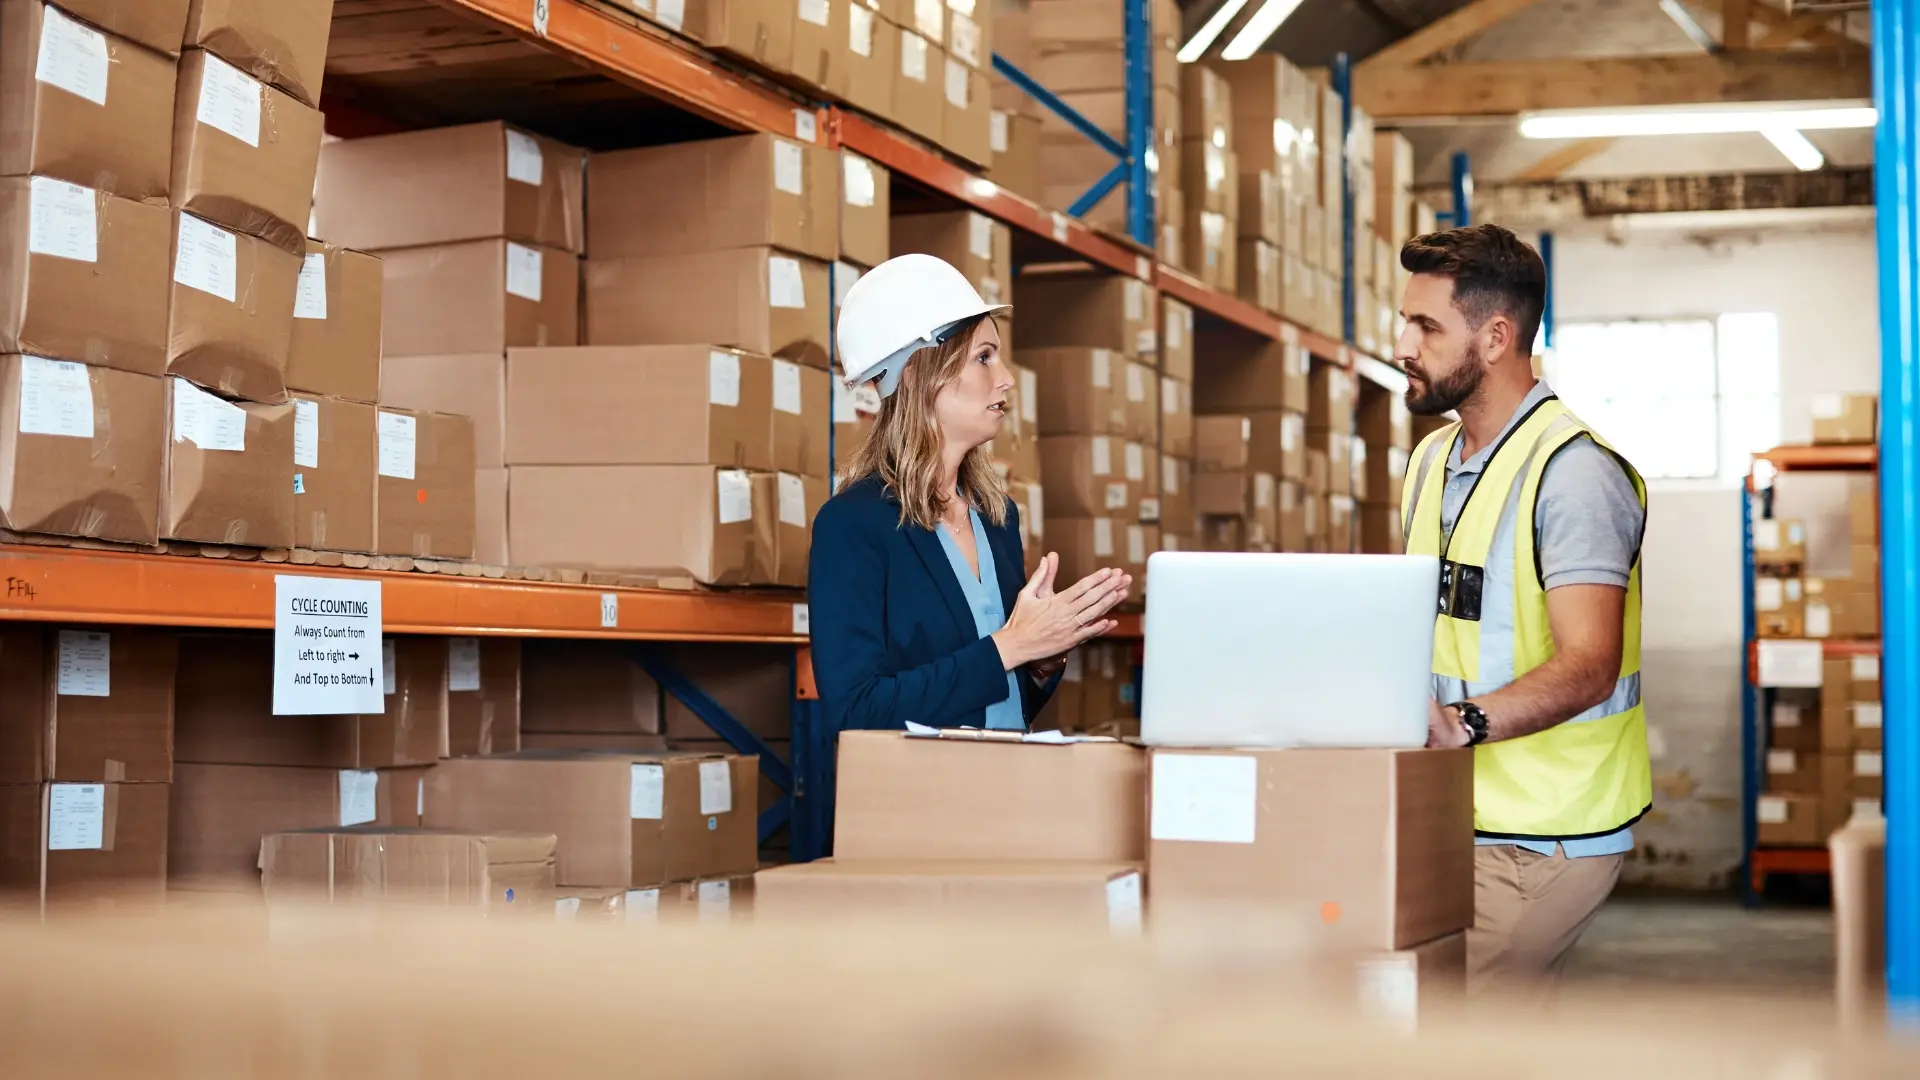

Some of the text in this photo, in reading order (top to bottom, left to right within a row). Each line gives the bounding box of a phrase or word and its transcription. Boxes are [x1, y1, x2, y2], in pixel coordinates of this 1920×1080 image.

[291, 598, 368, 615] CYCLE COUNTING
[604, 603, 616, 622] 10
[294, 625, 365, 640] Always Count from
[298, 649, 345, 664] Left to right
[294, 673, 368, 687] And Top to Bottom
